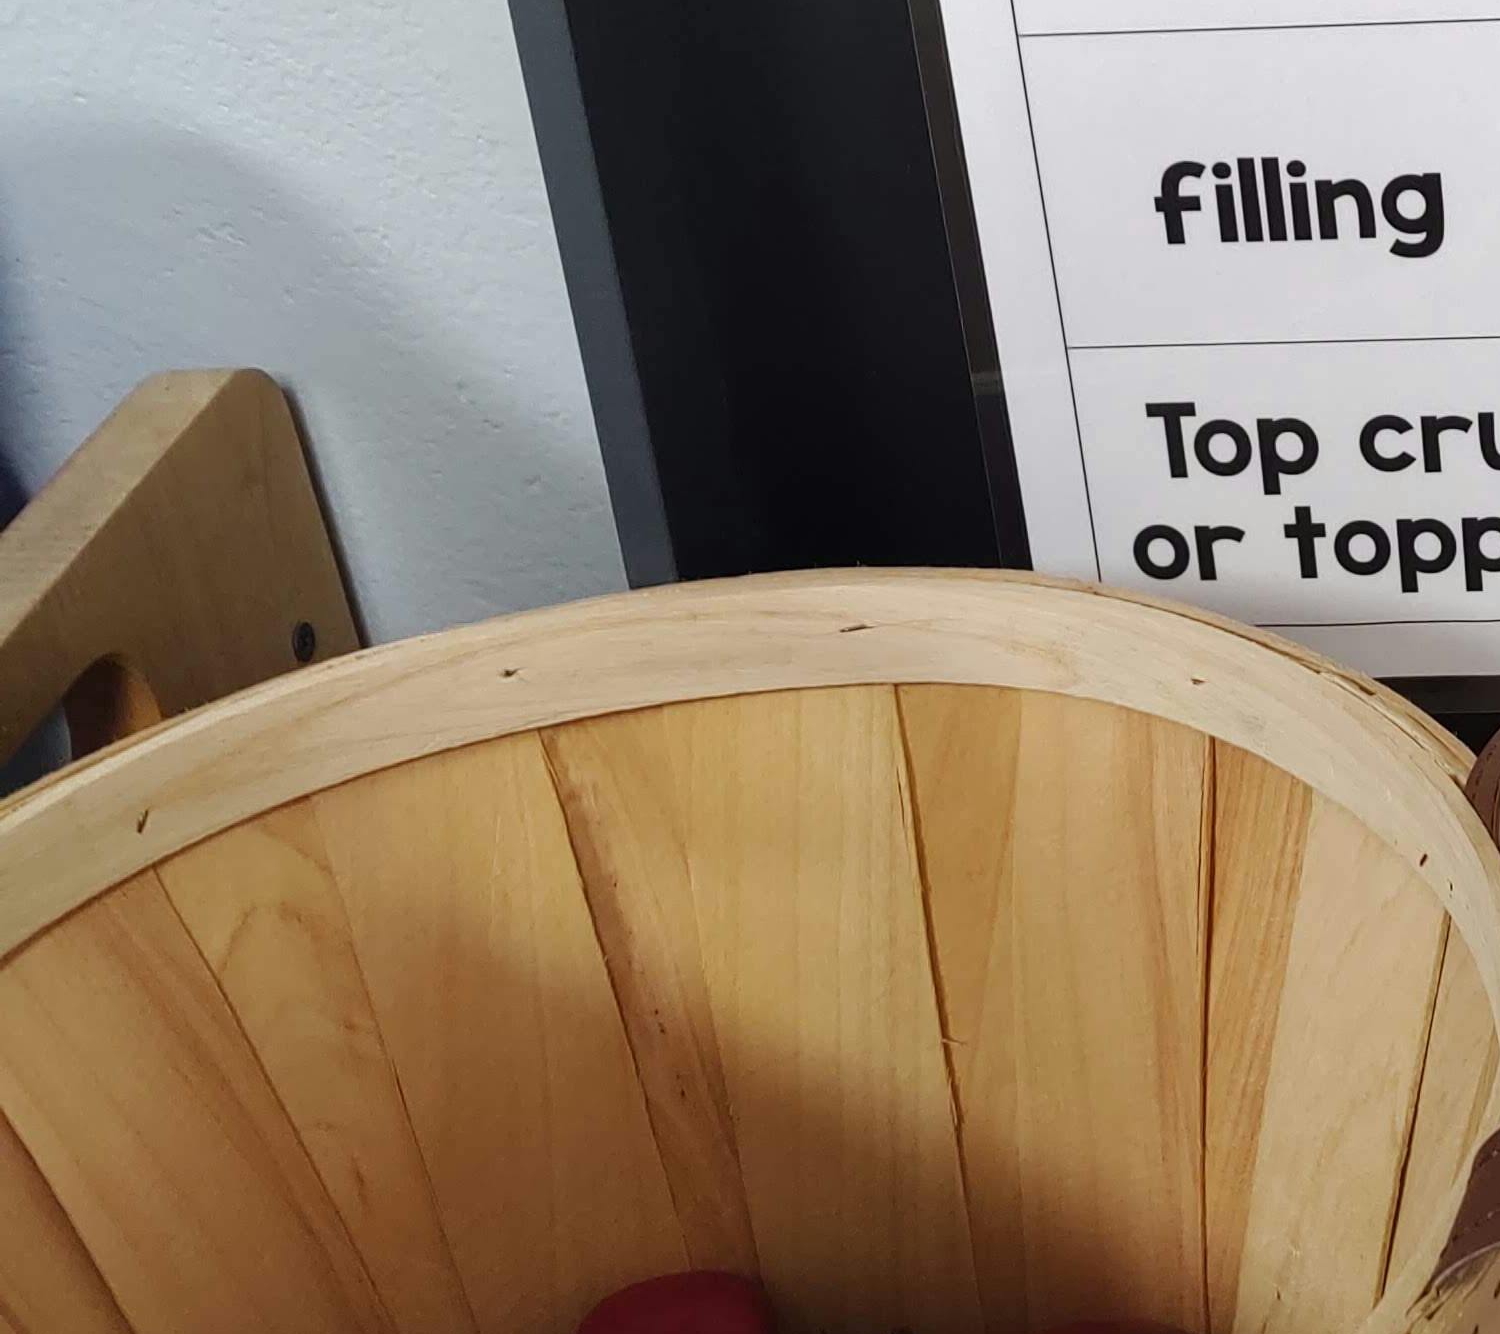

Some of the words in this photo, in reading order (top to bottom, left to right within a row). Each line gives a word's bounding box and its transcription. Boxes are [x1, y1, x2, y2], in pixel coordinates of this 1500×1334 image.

[1154, 157, 1445, 259] filling
[1145, 402, 1319, 496] Top
[1133, 524, 1246, 581] or
